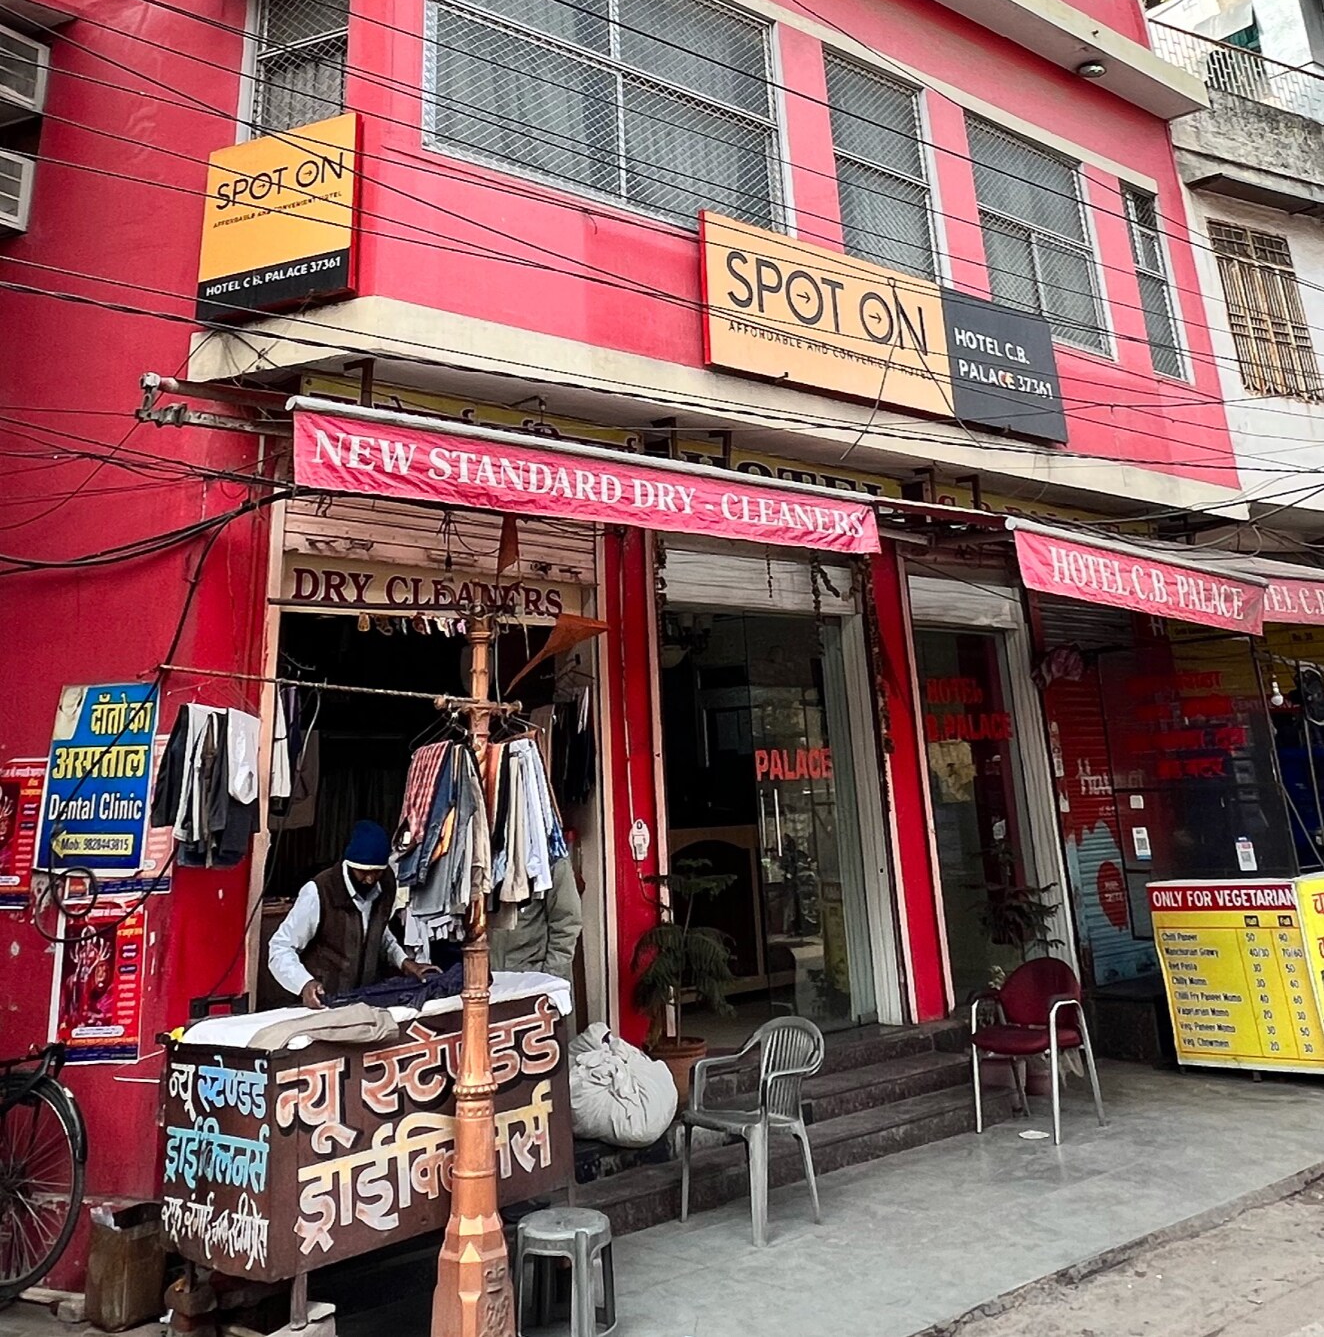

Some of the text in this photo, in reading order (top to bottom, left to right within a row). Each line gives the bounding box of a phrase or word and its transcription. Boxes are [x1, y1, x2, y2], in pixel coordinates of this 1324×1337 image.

[216, 152, 343, 210] SPOT ON
[206, 280, 241, 297] HOTEL
[265, 263, 308, 283] PALACE
[310, 256, 341, 273] 37361
[726, 250, 929, 356] SPOT ON
[728, 320, 802, 349] AFFORDABLE
[807, 342, 829, 356] AND
[953, 327, 1030, 364] HOTEL C.B.
[958, 359, 1054, 400] PALACE 37361
[311, 430, 416, 475] NEW
[428, 447, 622, 505] STANDARD
[632, 478, 696, 515] DRY
[720, 492, 865, 538] CLEANERS
[291, 567, 374, 603] DRY
[1049, 545, 1244, 621] HOTEL C.B. PALACE
[128, 702, 154, 734] का
[52, 745, 149, 779] अस्पताल
[754, 747, 834, 782] PALACE
[48, 792, 143, 821] Dental Clinic
[1152, 890, 1183, 908] ONLY
[1186, 890, 1213, 908] FOR
[1213, 888, 1296, 907] VEGETARIAN
[1245, 932, 1256, 943] 50
[1285, 963, 1296, 973] 50
[169, 1062, 197, 1122] न्यू
[275, 1056, 358, 1154] न्यू
